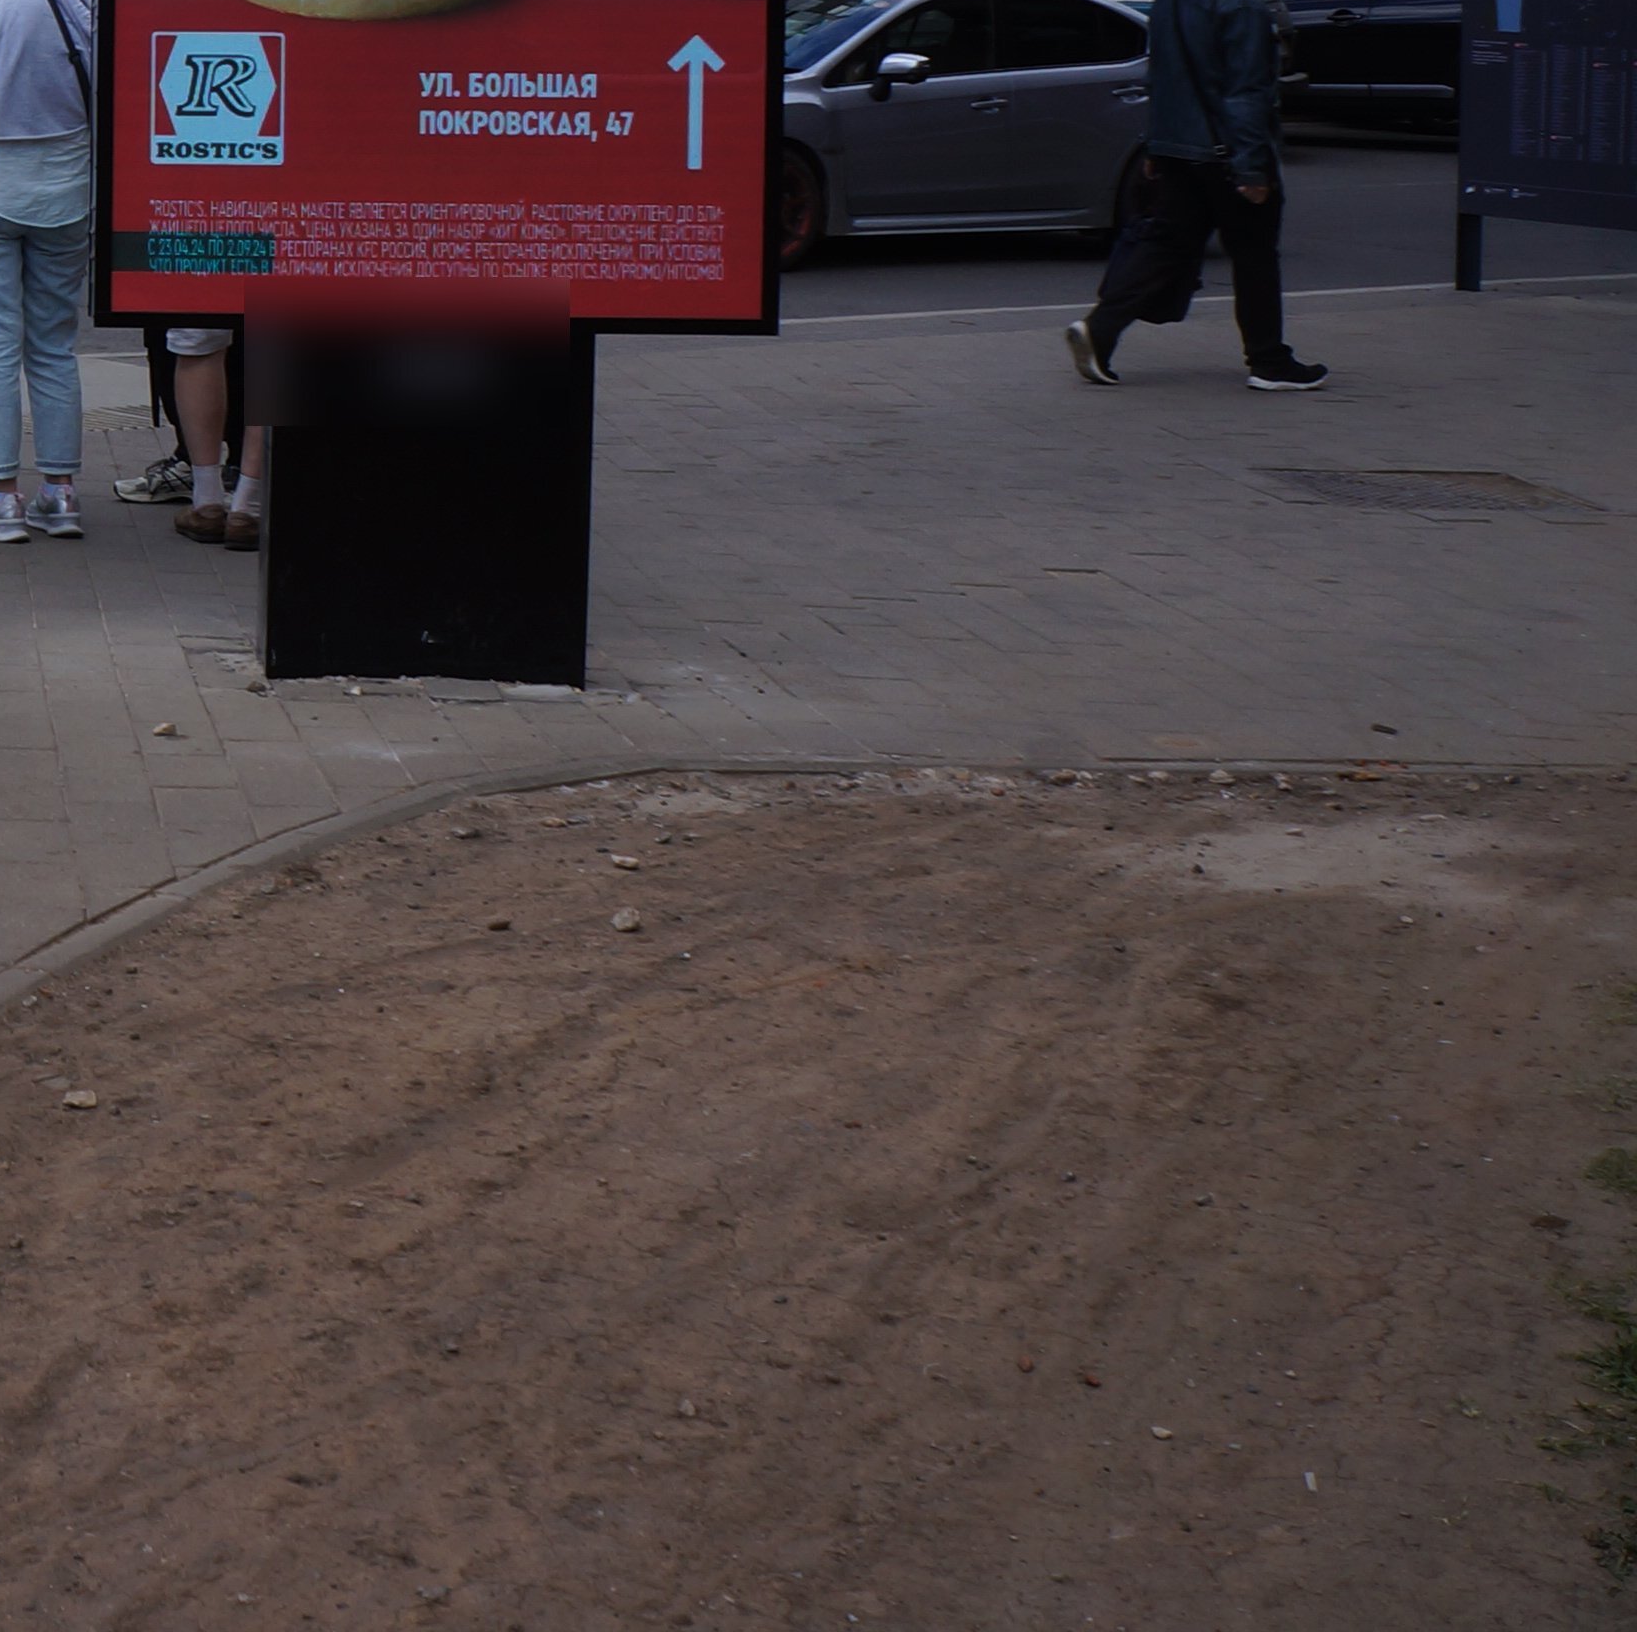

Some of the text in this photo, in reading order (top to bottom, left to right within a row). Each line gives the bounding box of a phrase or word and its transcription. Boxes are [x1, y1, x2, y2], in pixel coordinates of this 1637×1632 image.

[419, 72, 597, 98] УЛ. БОЛЬШАЯ
[419, 110, 634, 142] ПОКРОВСКАЯ, 47
[156, 142, 278, 159] ROSTIC'S
